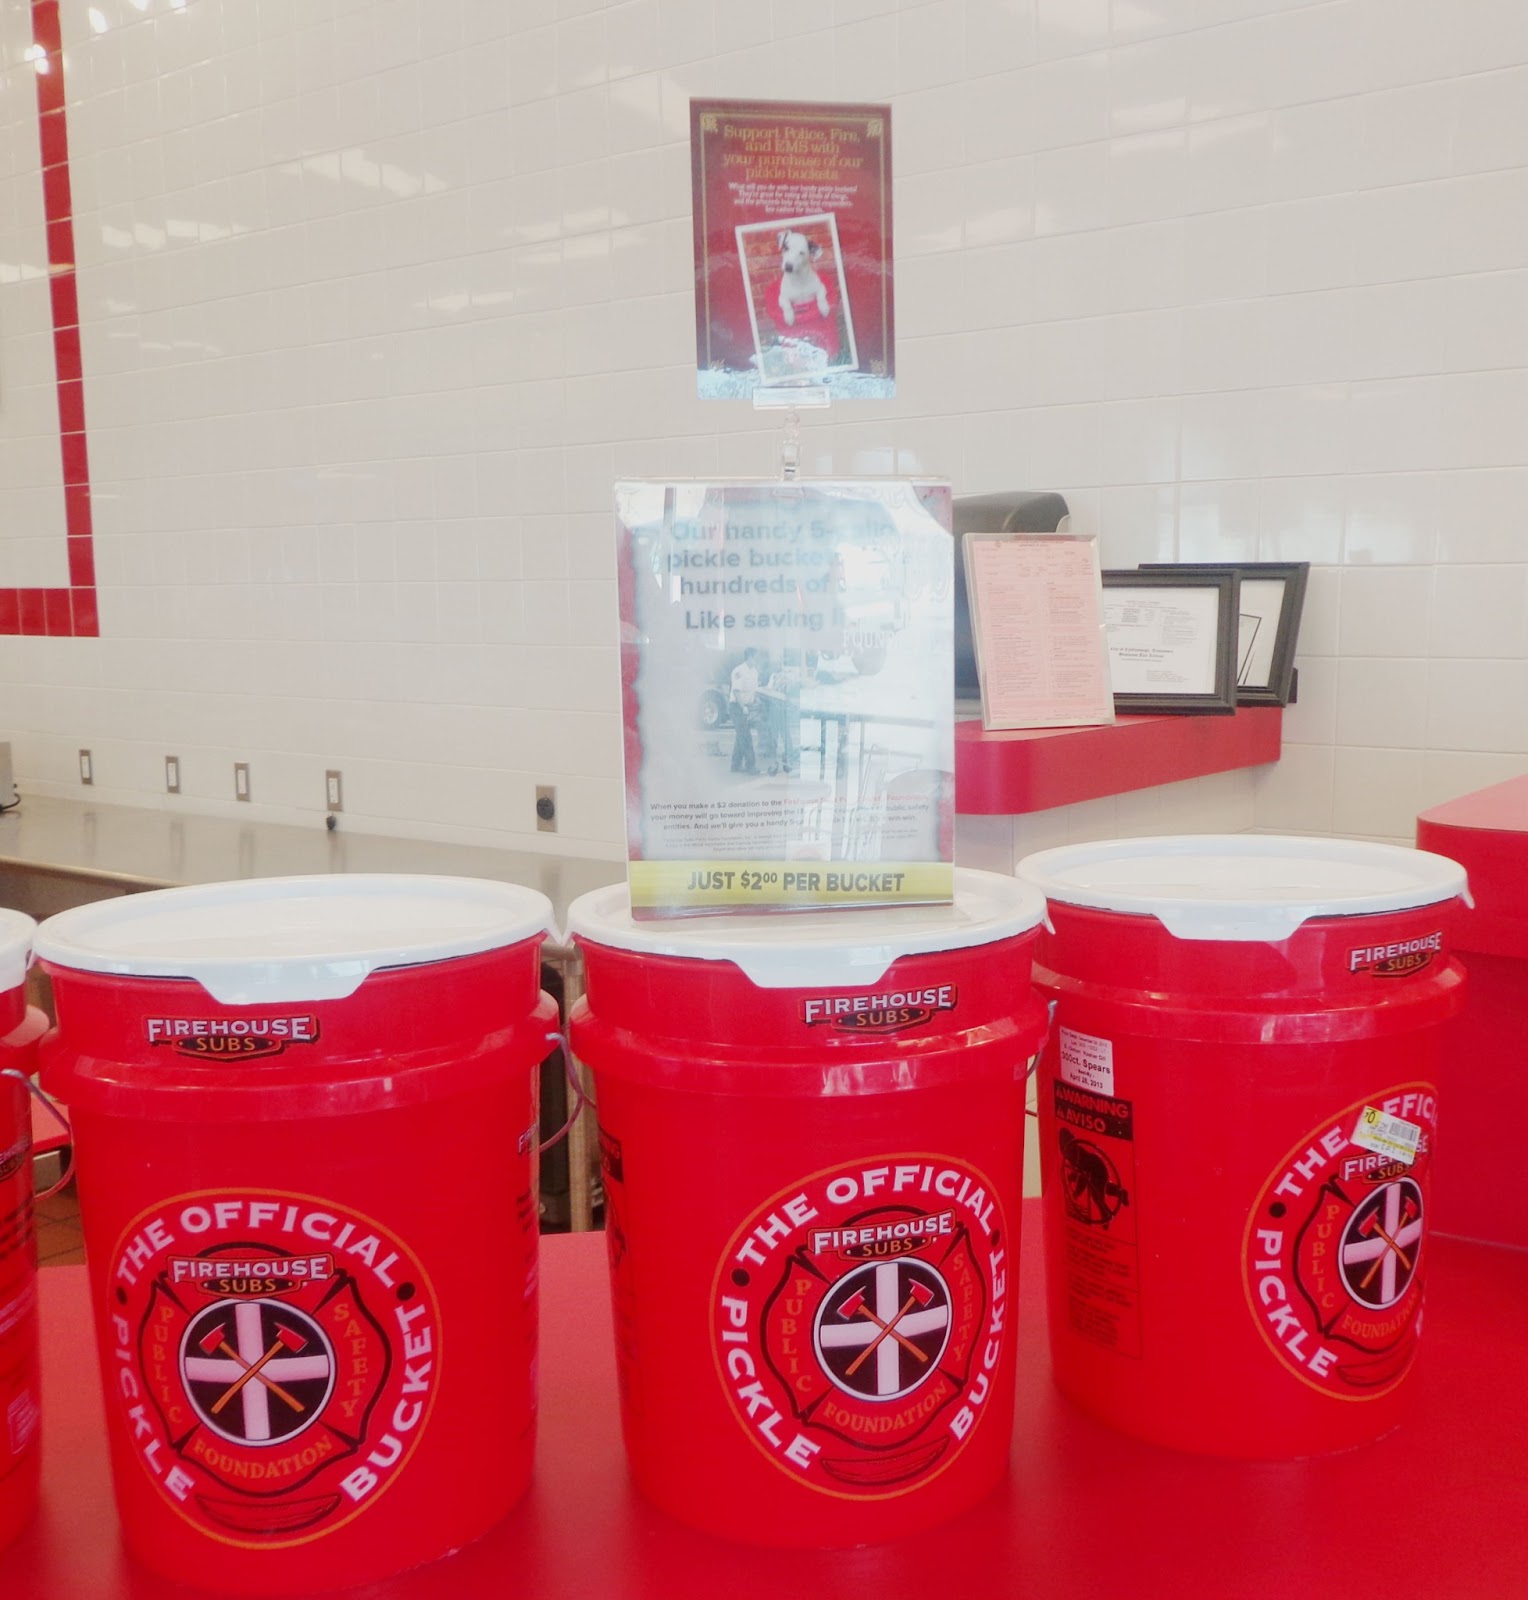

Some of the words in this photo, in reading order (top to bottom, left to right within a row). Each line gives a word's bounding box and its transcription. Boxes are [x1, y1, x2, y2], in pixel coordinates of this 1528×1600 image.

[724, 125, 779, 141] Support
[784, 126, 828, 141] Police,
[831, 128, 861, 142] Fire,
[745, 140, 771, 152] and
[775, 140, 808, 153] EMS
[811, 142, 840, 153] with
[724, 153, 755, 166] your
[758, 154, 822, 168] purchase
[824, 154, 839, 166] of
[840, 157, 864, 168] our
[745, 167, 785, 181] pickle
[671, 521, 718, 541] Our
[725, 519, 801, 543] handy
[667, 549, 740, 572] pickle
[679, 574, 797, 596] hundreds
[804, 573, 830, 595] of
[685, 610, 736, 630] Like
[743, 609, 824, 632] saving
[688, 871, 735, 890] JUST
[783, 872, 820, 891] PER
[826, 873, 904, 892] BUCKET
[1350, 931, 1442, 971] FIREHOUSE
[1387, 953, 1421, 971] SUBS
[805, 986, 951, 1023] FIREHOUSE
[856, 1009, 910, 1026] SUBS
[147, 1017, 311, 1043] FIREHOUSE
[196, 1037, 255, 1051] SUBS
[1083, 1058, 1111, 1074] Spears
[1063, 1088, 1129, 1118] WARNING
[1066, 1108, 1106, 1133] AVISO
[1274, 1126, 1349, 1199] THE
[826, 1164, 998, 1237] OFFICIAL
[179, 1200, 400, 1289] OFFICIAL
[736, 1193, 819, 1266] THE
[814, 1212, 953, 1255] FIREHOUSE
[862, 1238, 914, 1257] SUBS
[116, 1217, 175, 1288] THE
[172, 1257, 328, 1283] FIREHOUSE
[1312, 1204, 1340, 1310] PUBLIC
[219, 1278, 277, 1293] SUBS
[1255, 1228, 1339, 1378] PICKLE
[954, 1253, 973, 1362] SAFETY
[781, 1280, 812, 1393] PUBLIC
[949, 1248, 1005, 1442] BUCKET
[153, 1305, 182, 1424] PUBLIC
[333, 1303, 368, 1419] SAFETY
[721, 1294, 821, 1470] PICKLE
[112, 1313, 196, 1501] PICKLE
[340, 1302, 432, 1502] BUCKET
[822, 1381, 949, 1434] FOUNDATION
[193, 1435, 333, 1479] FOUNDATION
